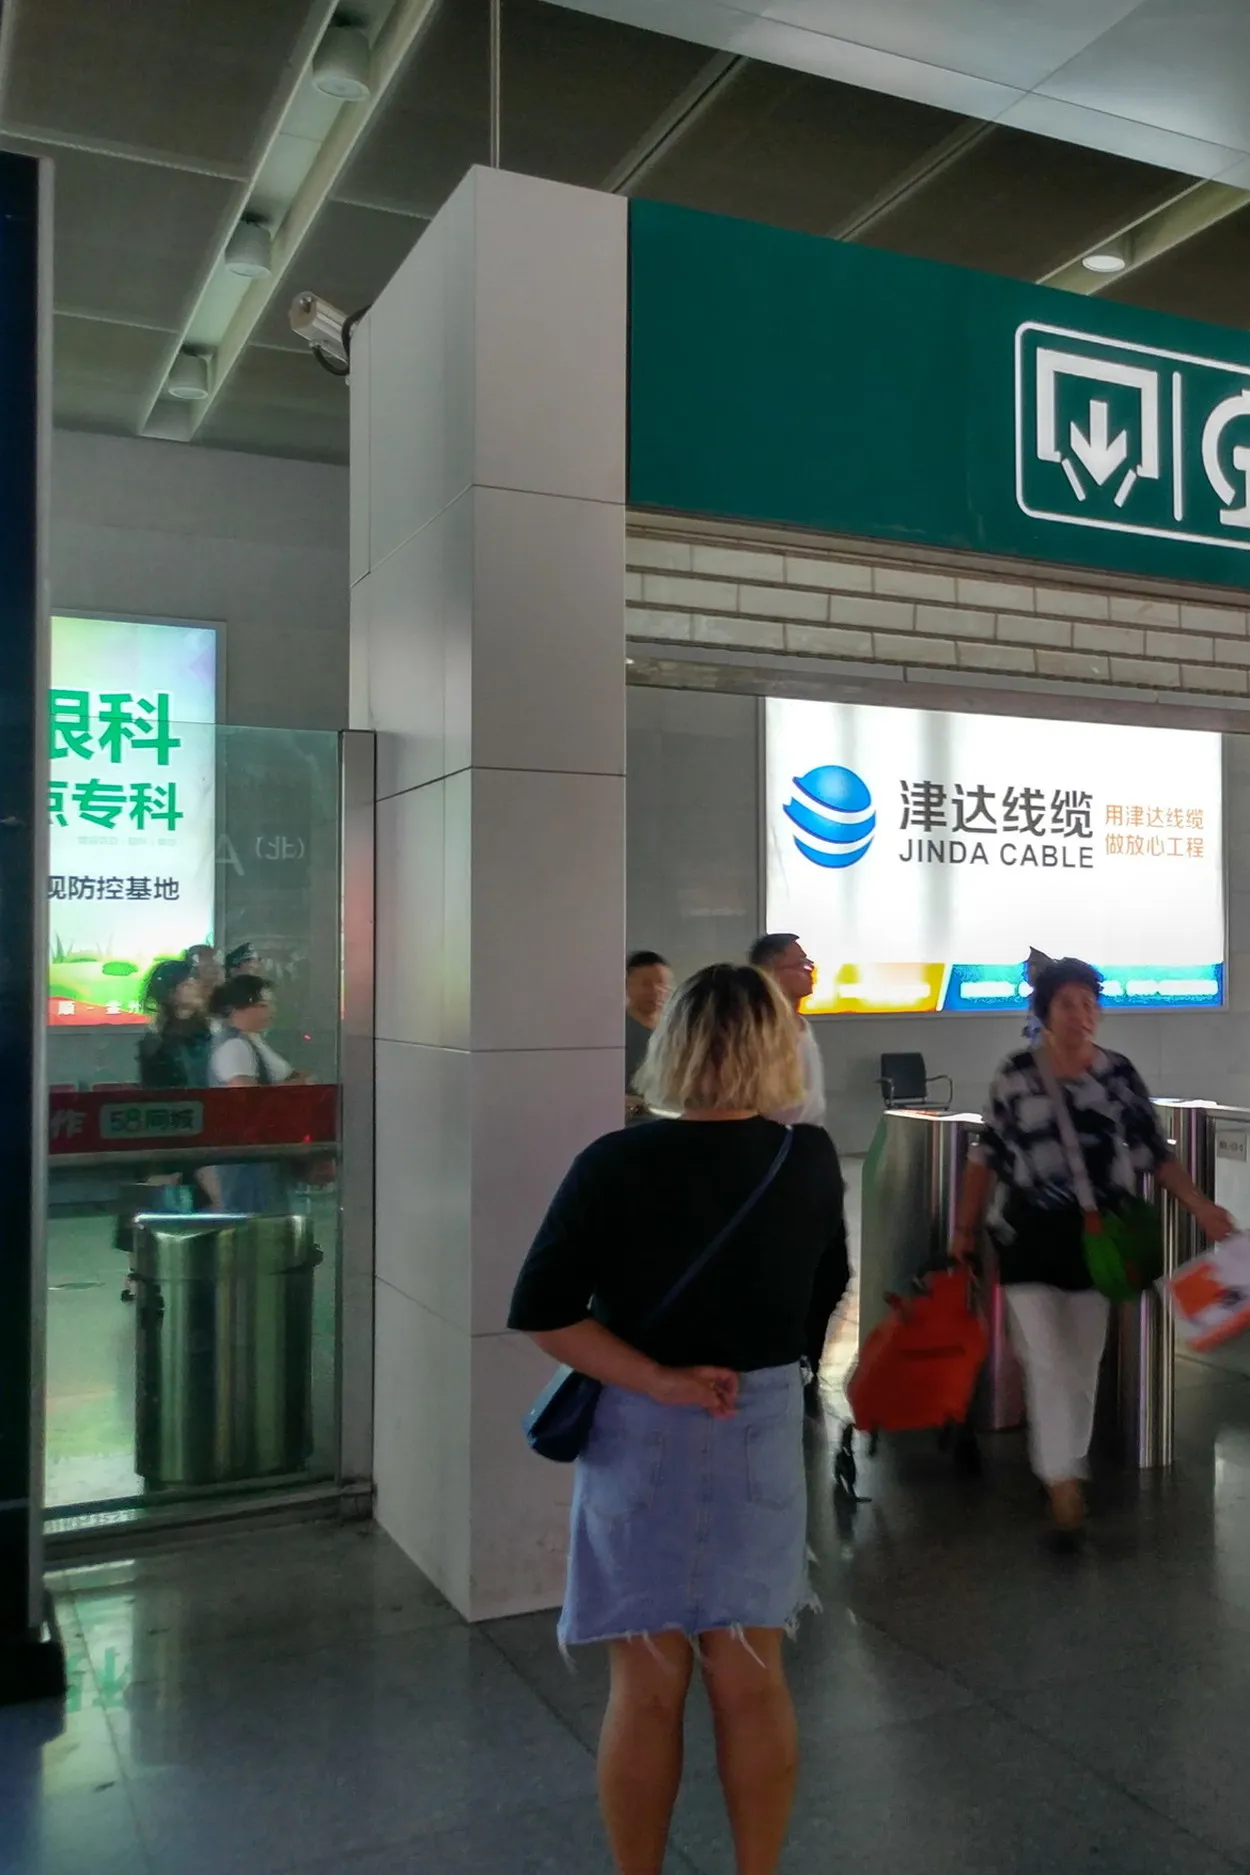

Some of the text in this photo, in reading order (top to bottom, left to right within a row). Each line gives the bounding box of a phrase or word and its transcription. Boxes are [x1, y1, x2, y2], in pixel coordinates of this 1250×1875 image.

[899, 780, 1093, 838] 津达线缆
[1105, 804, 1204, 830] 用津达线缆
[899, 839, 1093, 869] JINDA CABLE
[1105, 833, 1204, 858] 做放心工程
